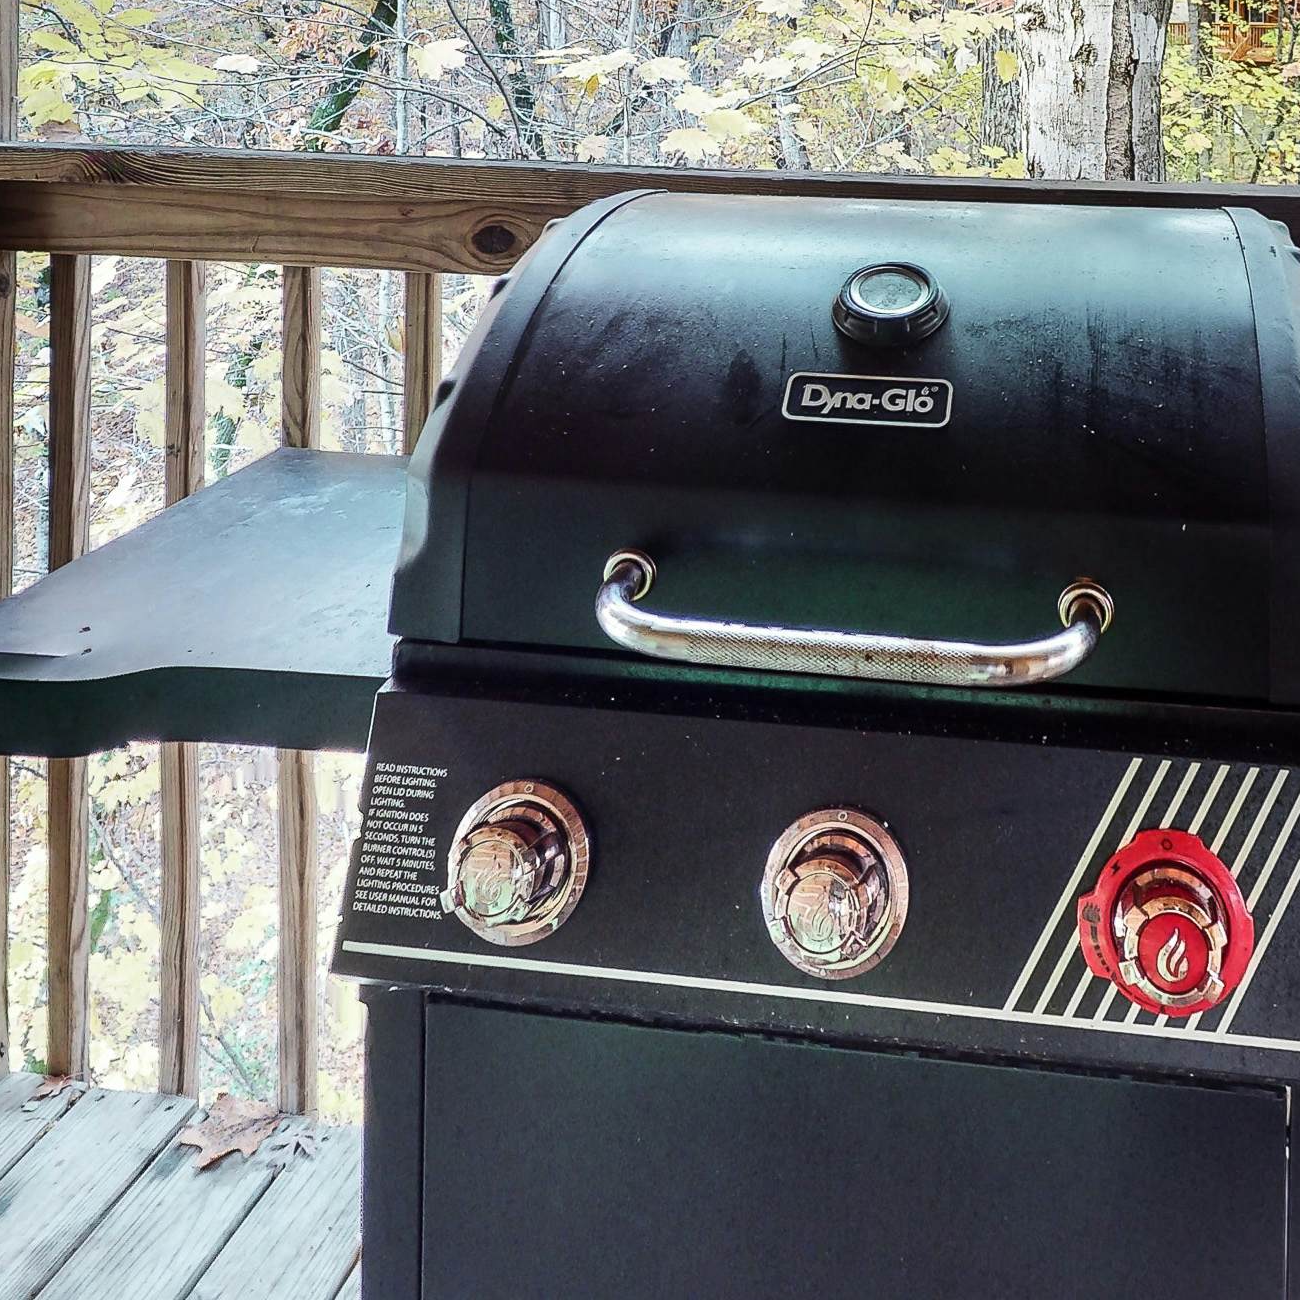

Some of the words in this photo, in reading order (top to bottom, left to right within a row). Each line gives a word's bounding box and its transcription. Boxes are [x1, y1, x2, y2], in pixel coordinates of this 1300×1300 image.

[801, 383, 934, 414] Dyna-Glo
[376, 763, 396, 772] READ
[396, 765, 448, 777] INSTRUCTIONS
[374, 774, 401, 784] BEFORE
[402, 776, 437, 788] LIGHTING.
[372, 786, 392, 795] OPEN
[393, 787, 405, 796] LID
[406, 788, 434, 799] DURING
[370, 797, 406, 808] LIGHTING.
[368, 808, 376, 816] IF
[376, 809, 408, 820] IGNITION
[409, 812, 429, 822] DOES
[366, 820, 382, 829] NOT
[383, 821, 409, 831] OCCUR
[409, 824, 418, 832] IN
[418, 825, 424, 833] 5
[401, 835, 420, 844] TURN
[421, 837, 436, 846] THE
[362, 843, 392, 853] BURNER
[392, 846, 436, 859] CONTROL(S)
[377, 856, 395, 865] WAIT
[396, 858, 401, 867] 5
[358, 867, 376, 876] AND
[376, 868, 403, 879] REPEAT
[404, 871, 418, 880] THE
[356, 878, 391, 890] LIGHTING
[355, 890, 369, 900] SEE
[369, 892, 388, 902] USER
[388, 893, 420, 906] MANUAL
[421, 897, 437, 907] FOR
[352, 901, 387, 914] DETAILED
[388, 906, 443, 920] INSTRUCTIONS.
